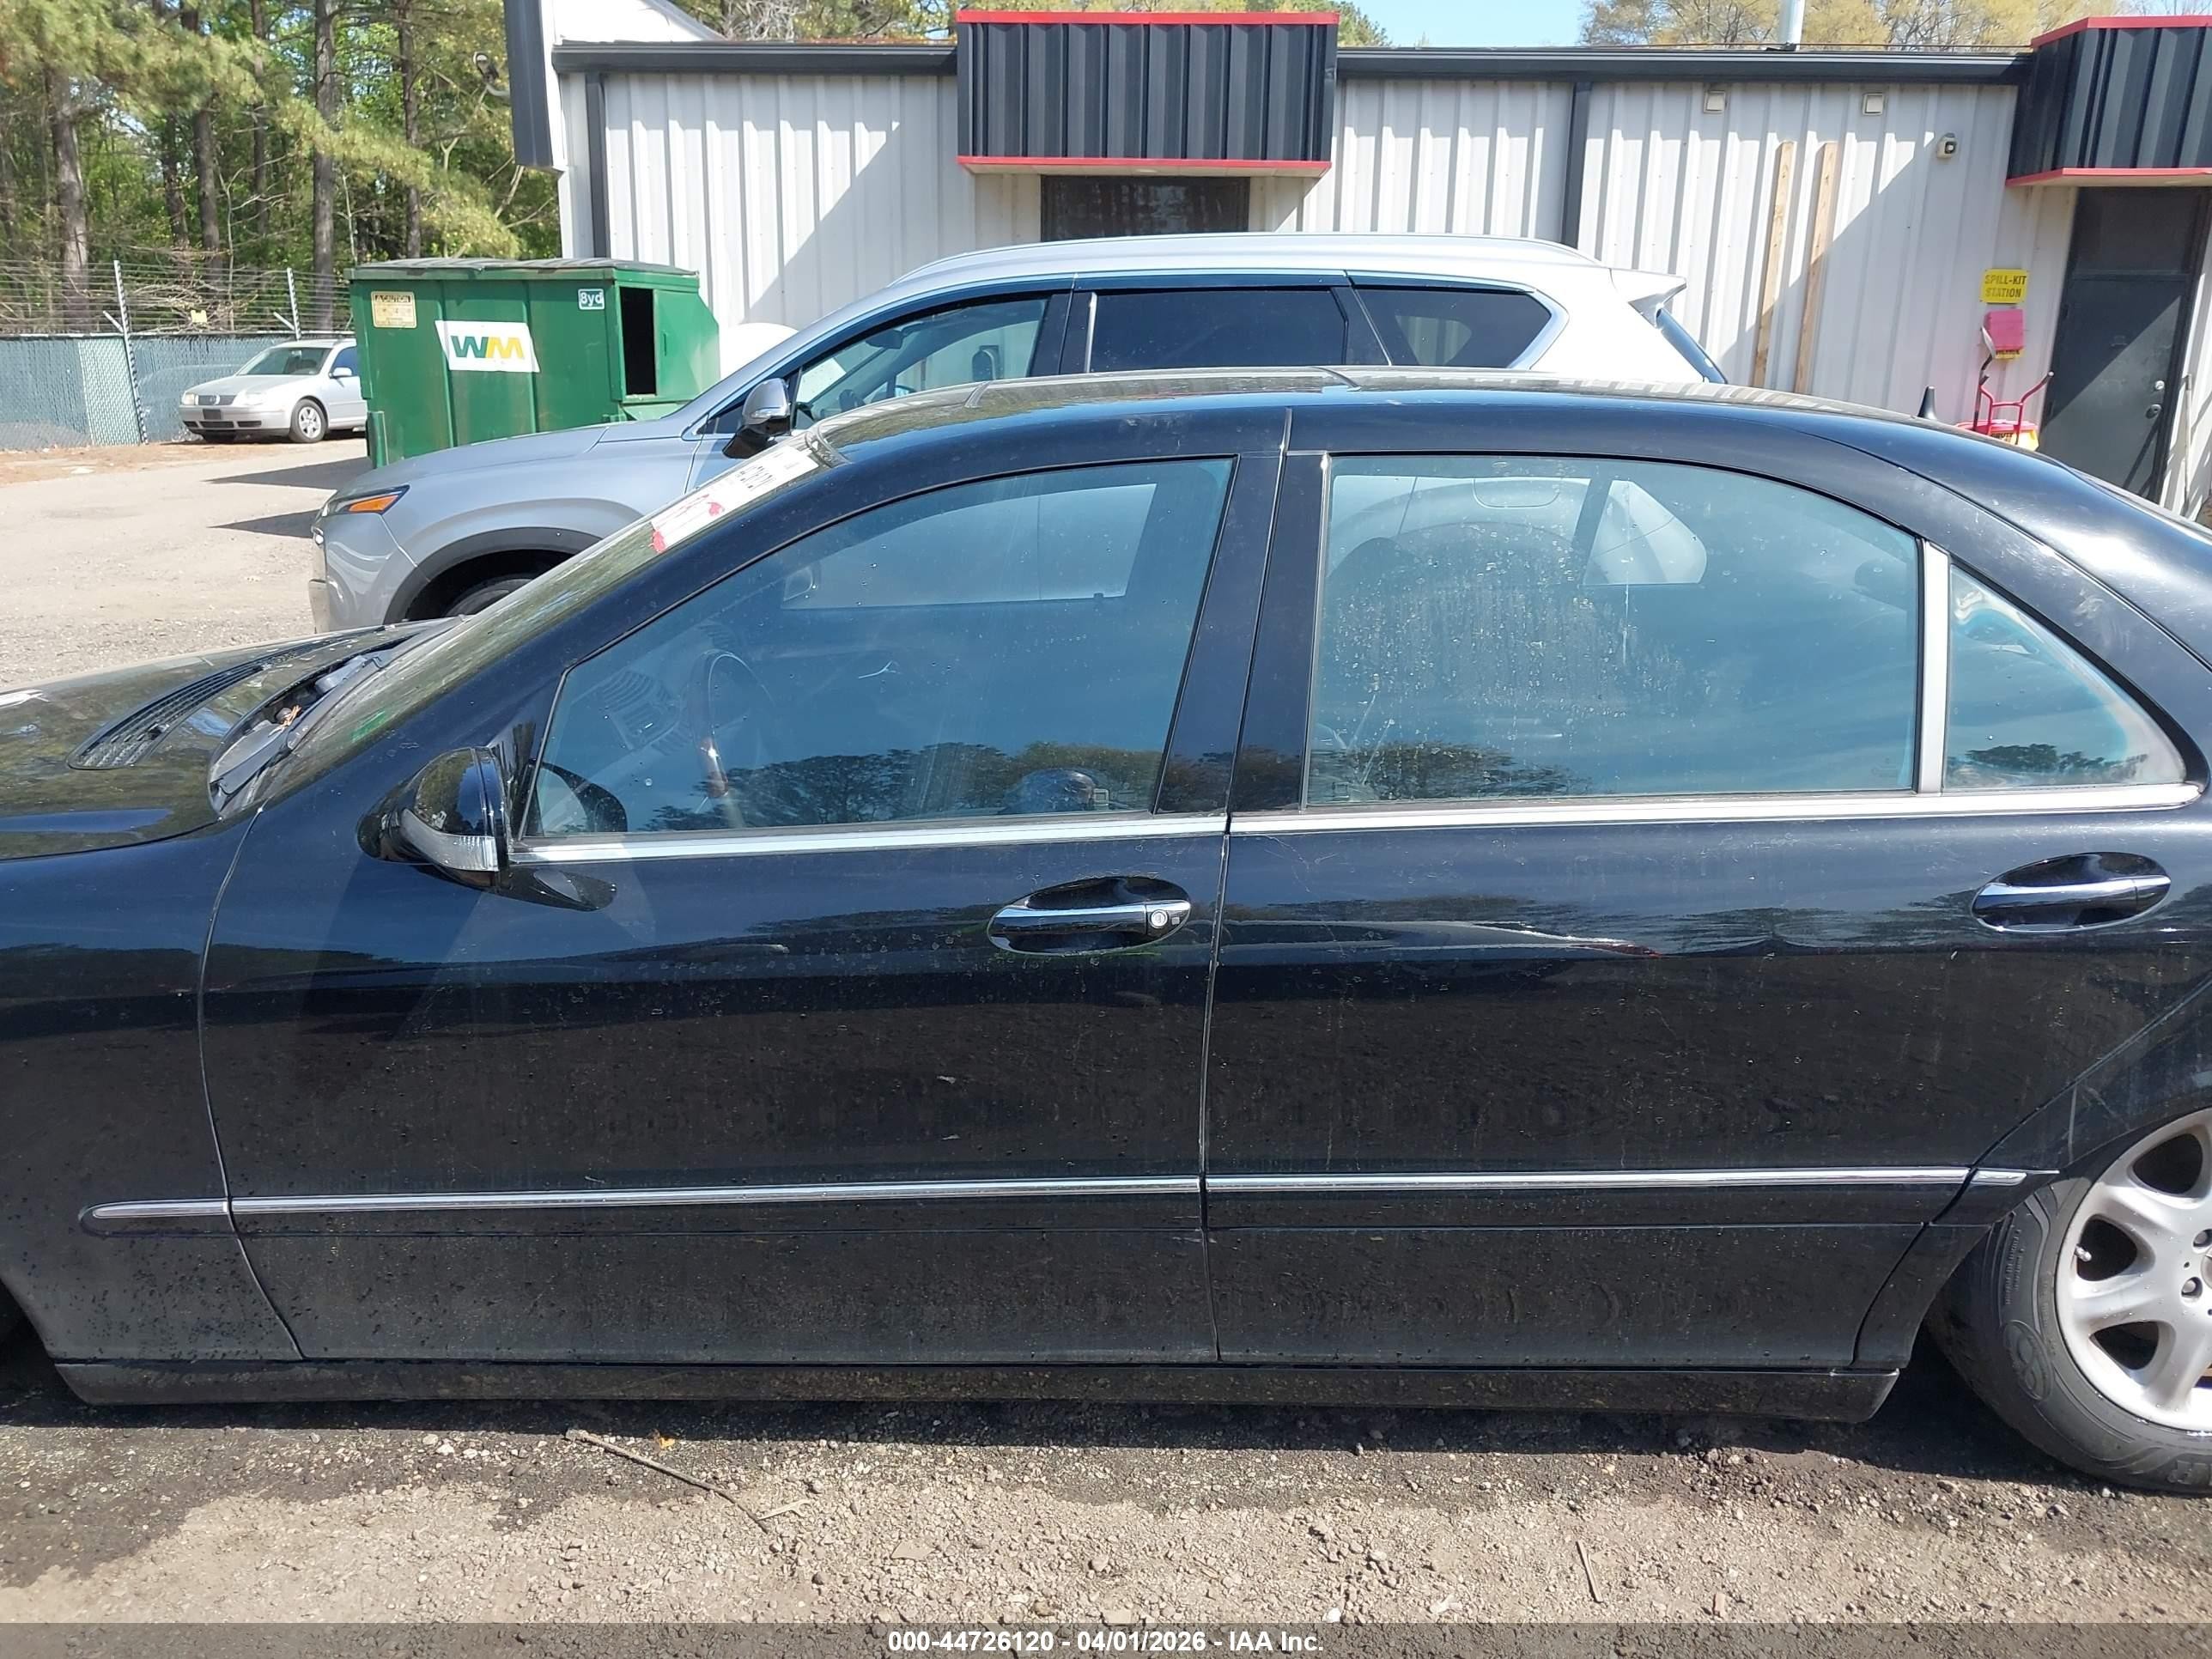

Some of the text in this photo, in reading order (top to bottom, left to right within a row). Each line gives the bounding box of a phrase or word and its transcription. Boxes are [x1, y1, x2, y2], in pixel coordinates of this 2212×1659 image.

[1984, 275, 2027, 285] SPILL-KIT
[1984, 288, 2022, 298] STATION
[580, 292, 604, 307] 8yd
[450, 335, 526, 359] WM
